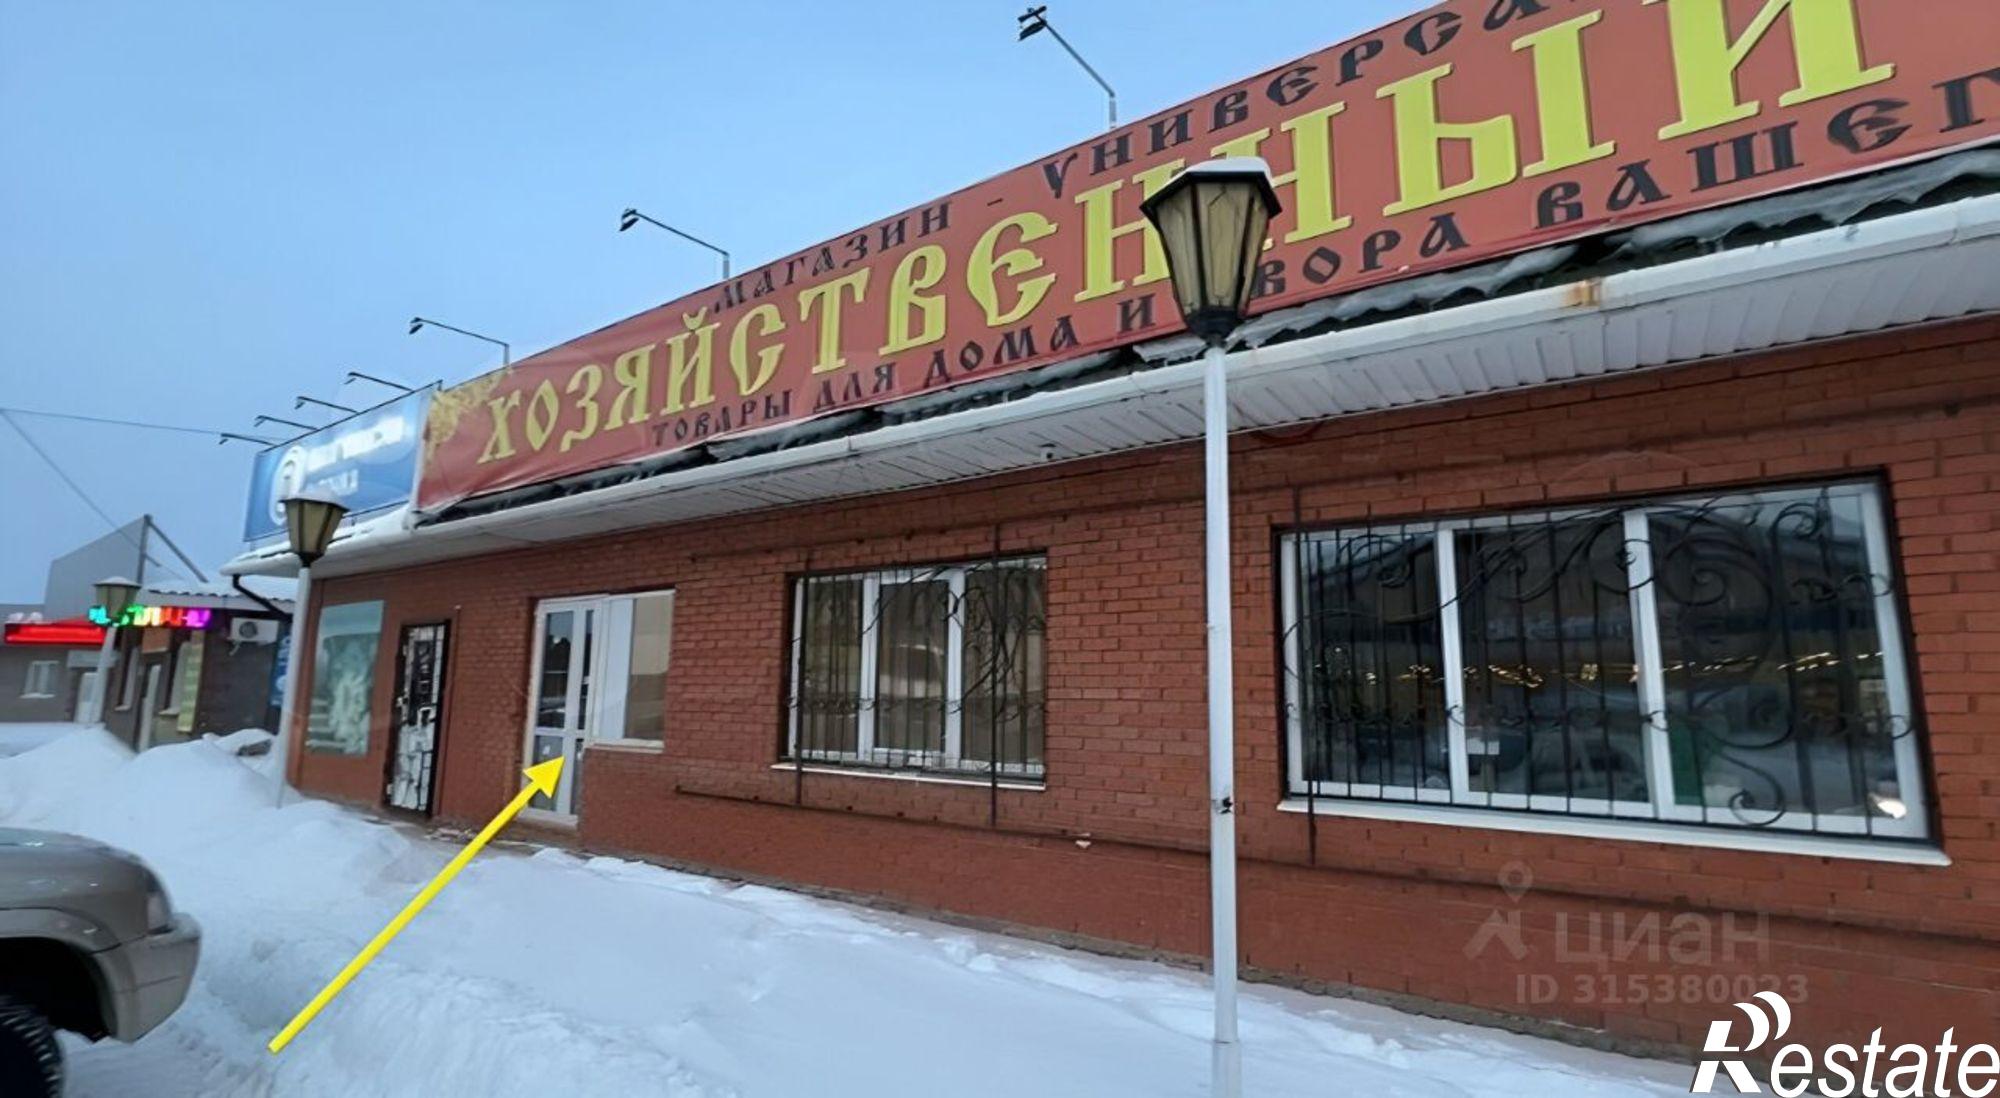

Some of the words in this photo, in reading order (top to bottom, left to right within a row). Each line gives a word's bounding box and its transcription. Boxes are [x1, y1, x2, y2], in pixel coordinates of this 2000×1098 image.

[476, 0, 1896, 464] ХОЗЯЙСТВЕННЫЙ
[714, 200, 953, 314] МАГАЗИН
[1042, 0, 1576, 199] УНИВЕРСА
[652, 388, 793, 447] ТОВАРЫ
[812, 362, 897, 414] ДЛЯ
[922, 314, 1081, 388] ДОМА
[1116, 293, 1156, 333] И
[1251, 211, 1471, 298] ВОРА
